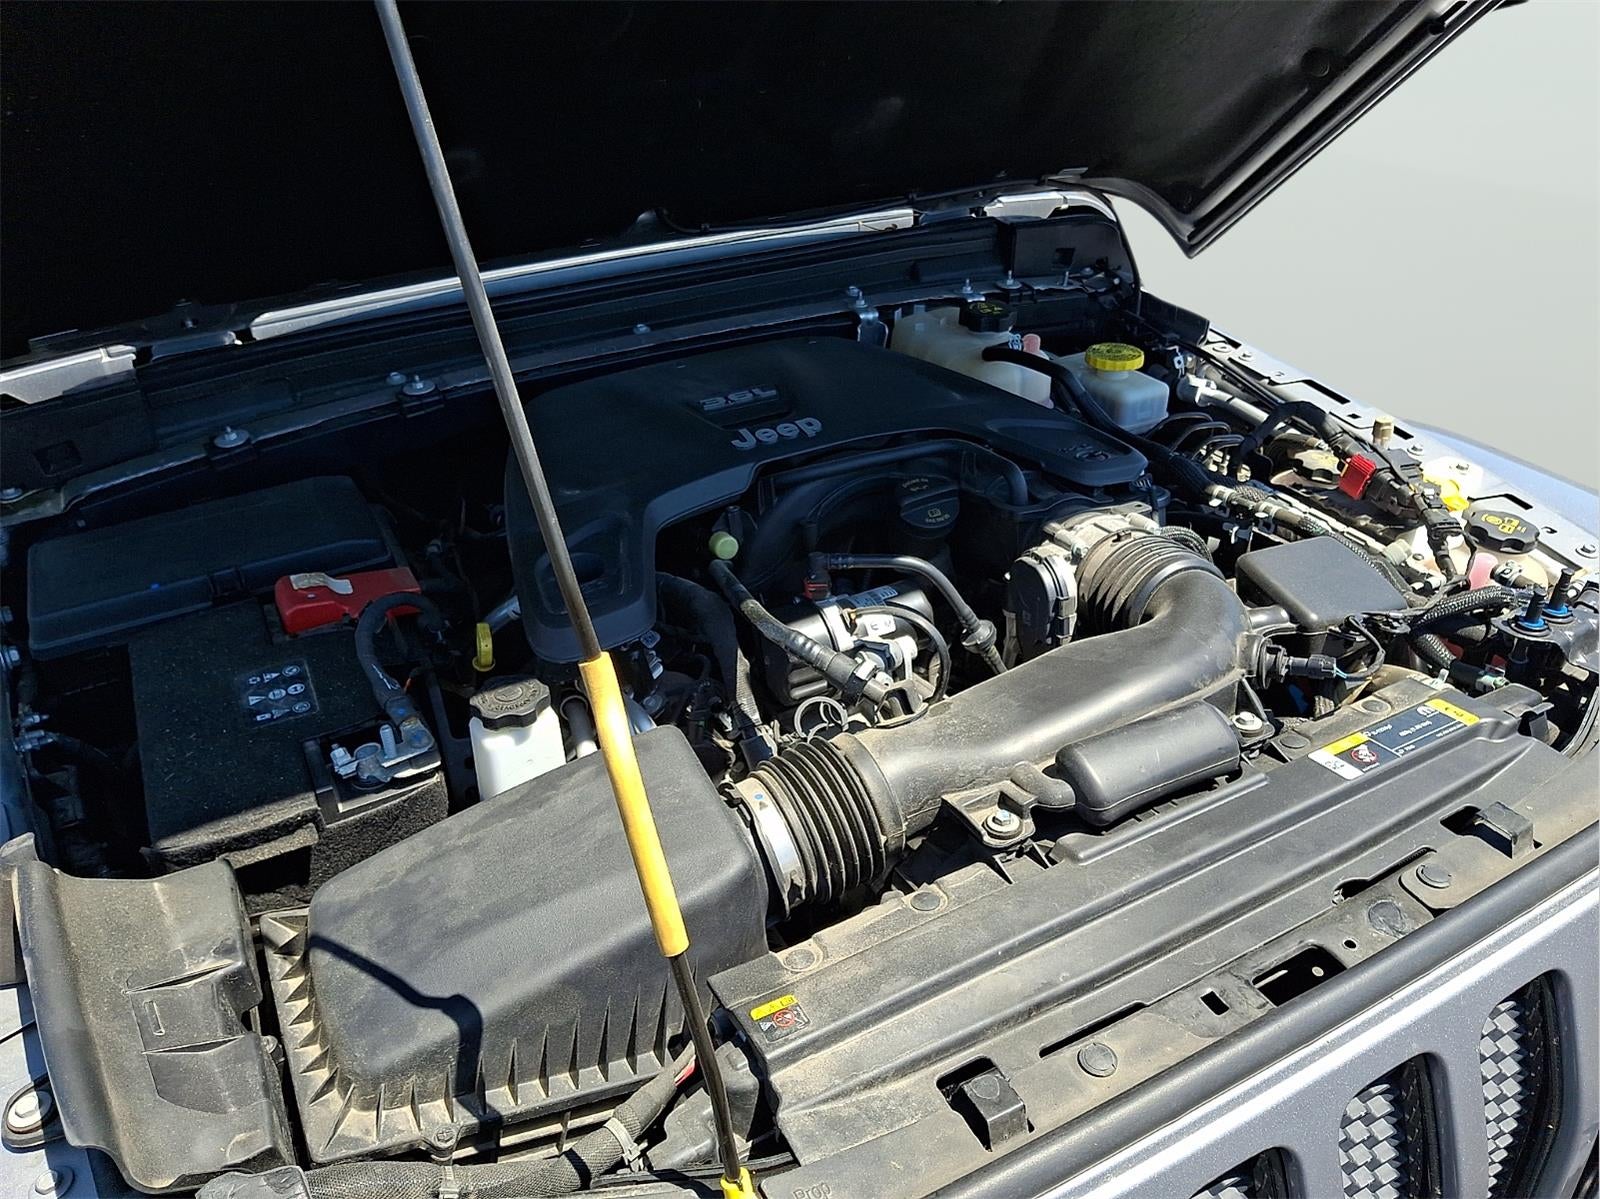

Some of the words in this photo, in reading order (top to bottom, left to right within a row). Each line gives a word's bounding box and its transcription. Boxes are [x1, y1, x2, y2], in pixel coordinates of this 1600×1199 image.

[700, 388, 777, 411] 3.6L
[731, 416, 823, 449] Jeep
[792, 1181, 831, 1199] Prop
